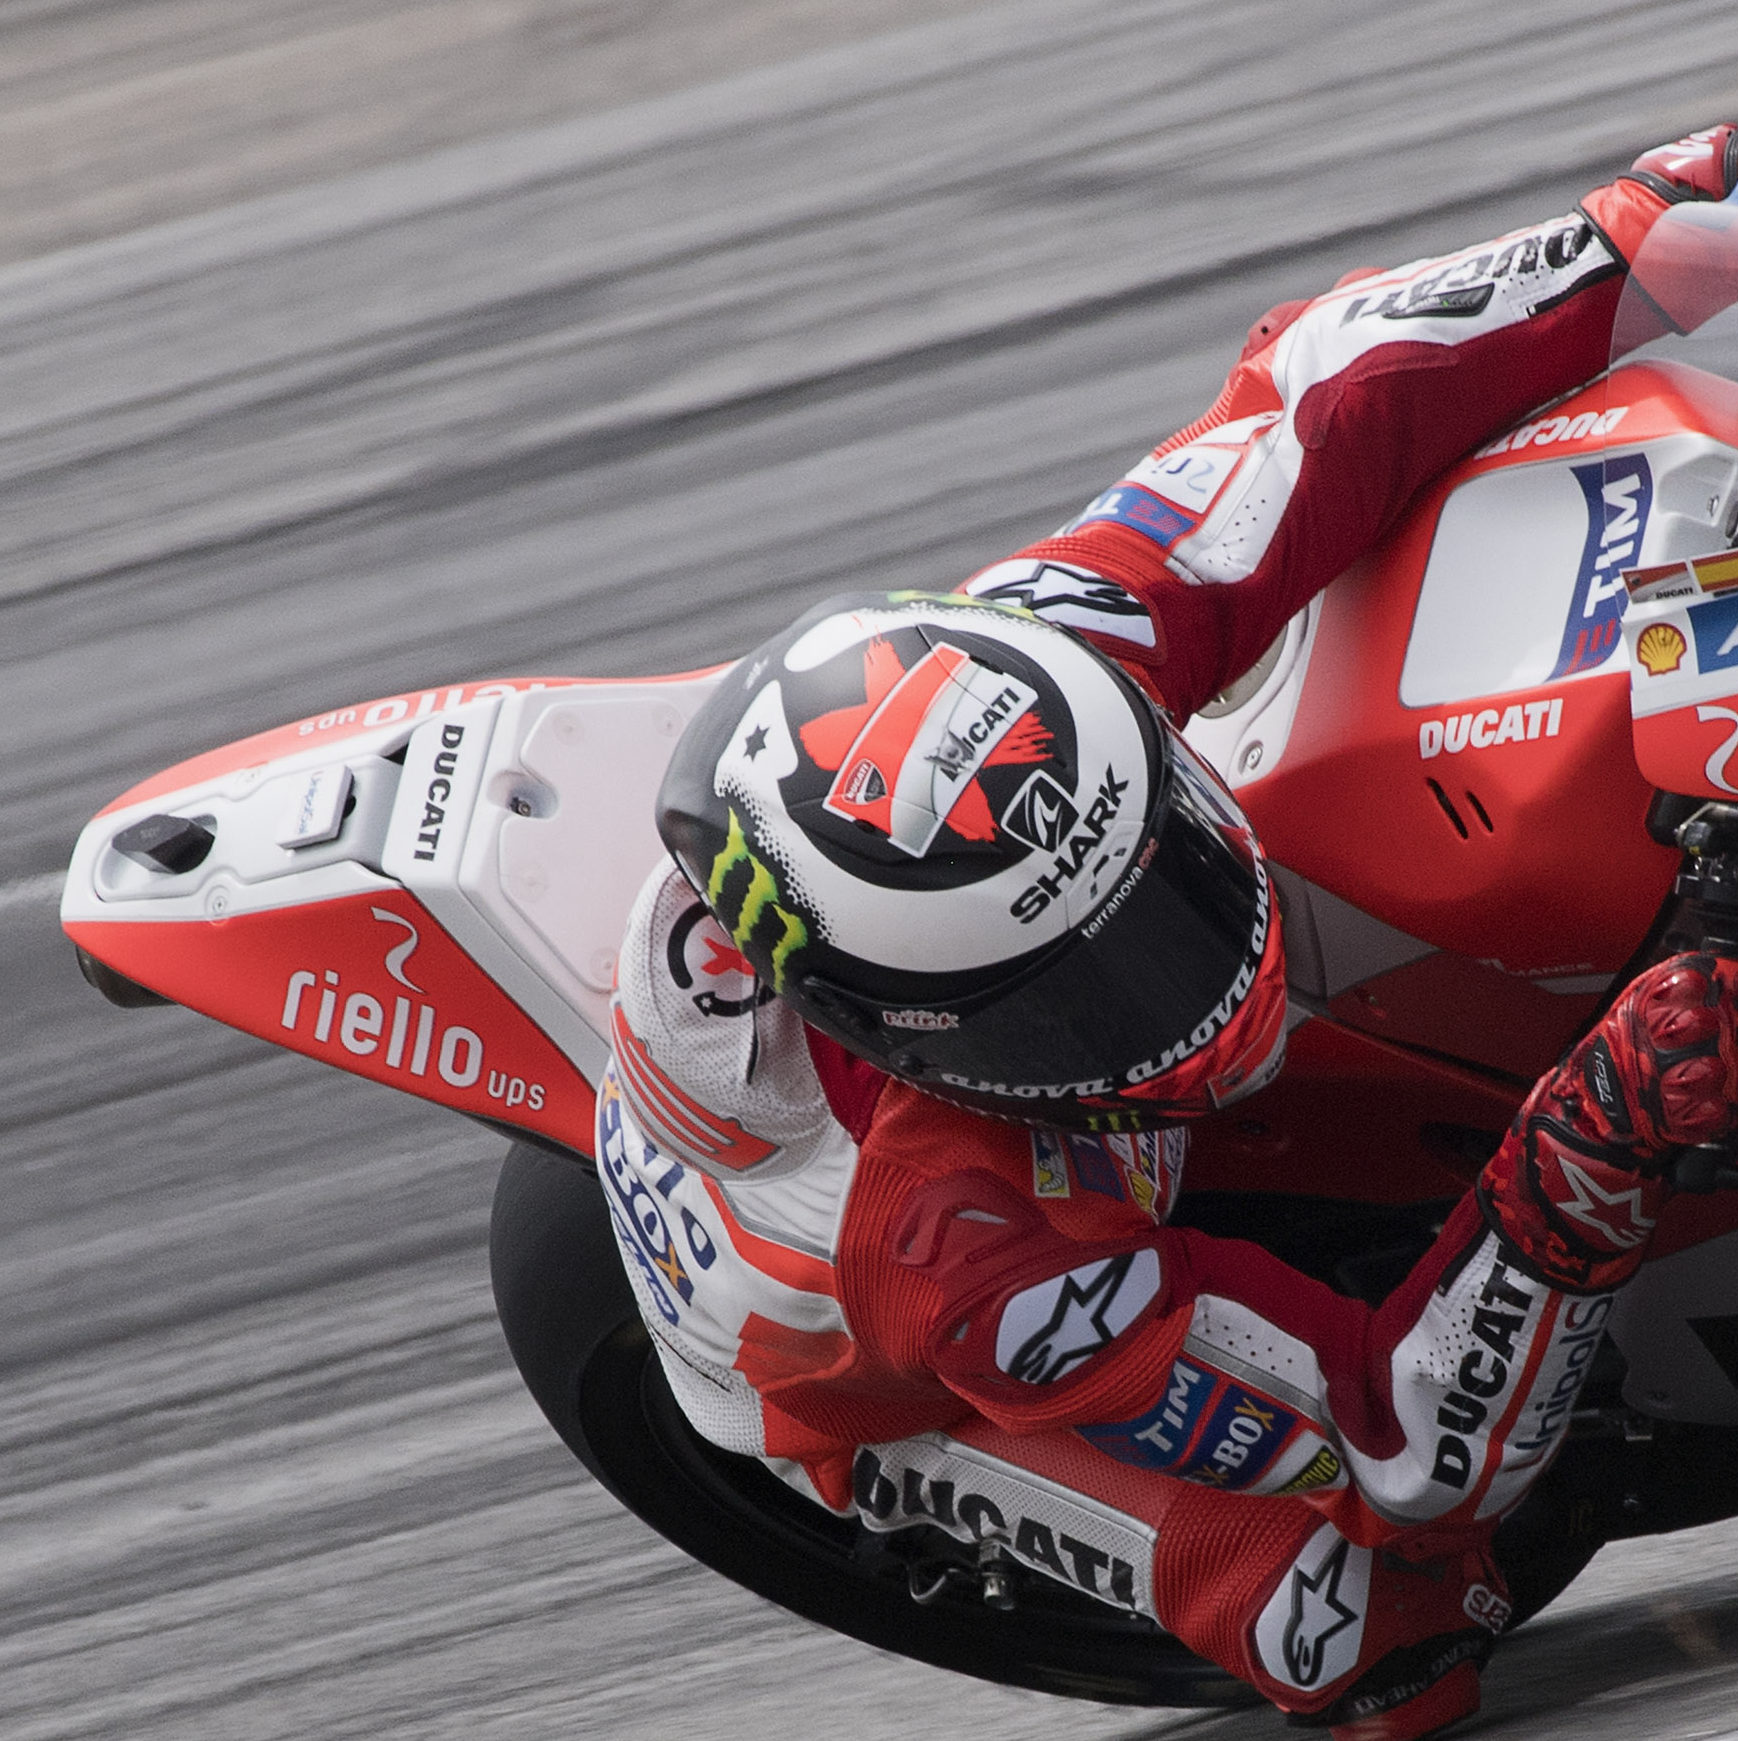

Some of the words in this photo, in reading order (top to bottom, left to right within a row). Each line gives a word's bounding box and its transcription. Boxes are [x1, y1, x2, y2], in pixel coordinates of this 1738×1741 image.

[1582, 473, 1642, 618] TIM
[1655, 587, 1694, 599] DUCATI
[298, 709, 356, 737] ups
[1419, 698, 1563, 760] DUCATI
[413, 723, 465, 862] DUCATI
[845, 762, 868, 803] DUCATI
[1010, 762, 1129, 925] SHARK
[1082, 865, 1143, 940] terranova
[280, 969, 483, 1089] riello
[488, 1069, 546, 1111] ups
[1134, 1360, 1201, 1453] TIM
[1503, 1294, 1614, 1473] UnipolS
[854, 1447, 1136, 1610] DUCATI
